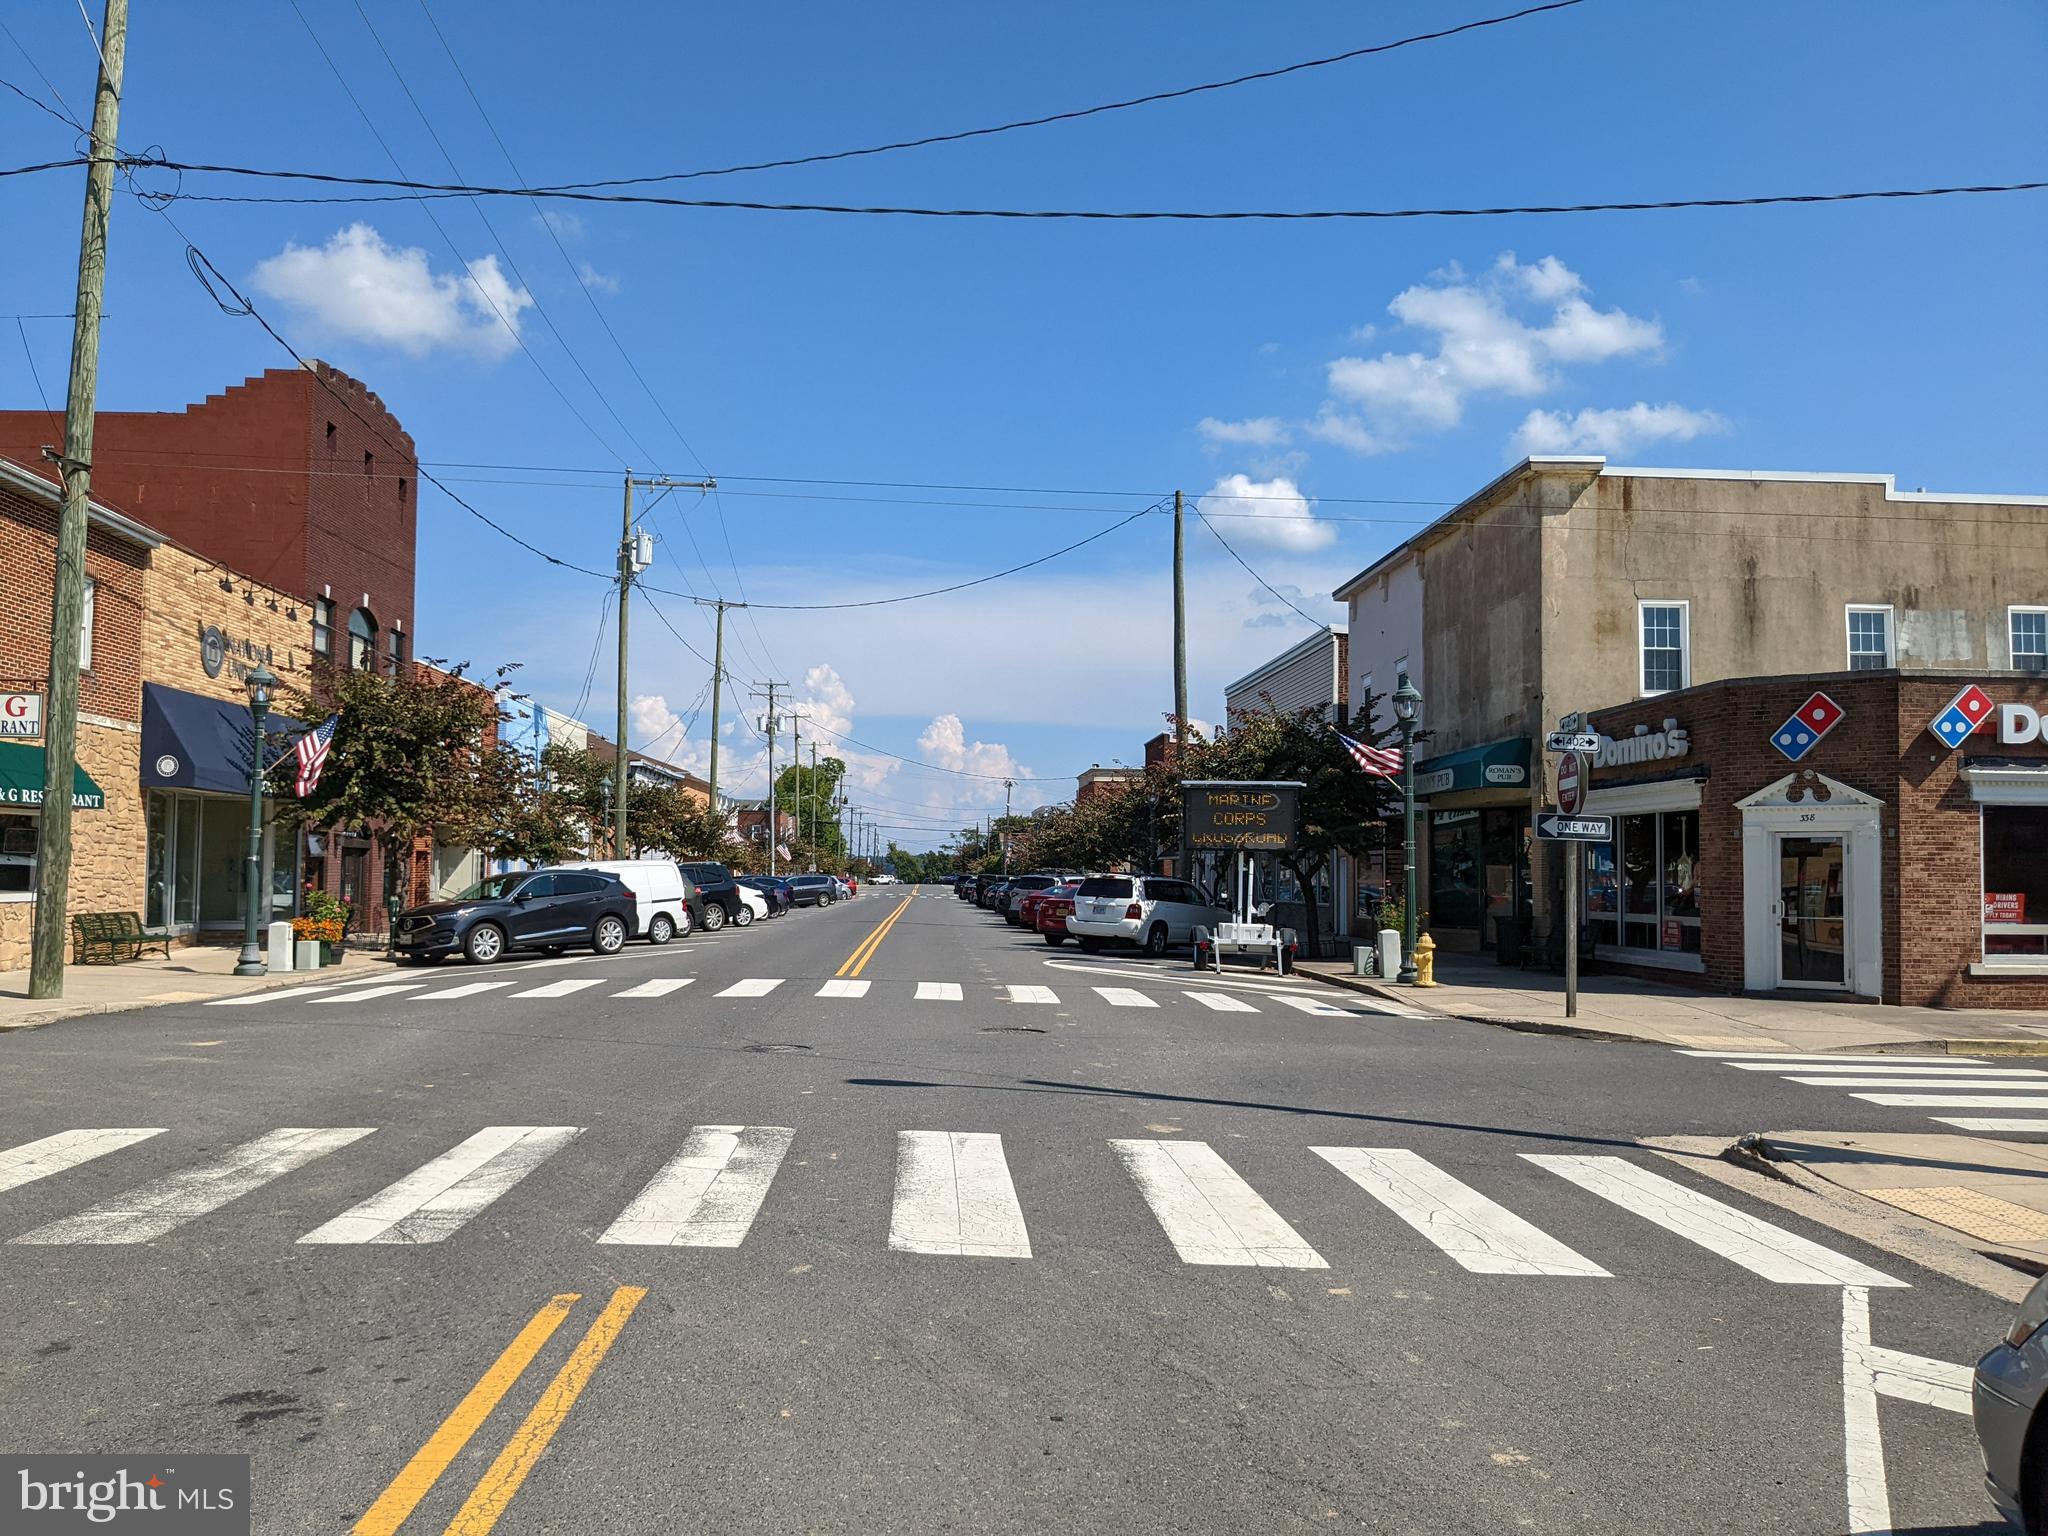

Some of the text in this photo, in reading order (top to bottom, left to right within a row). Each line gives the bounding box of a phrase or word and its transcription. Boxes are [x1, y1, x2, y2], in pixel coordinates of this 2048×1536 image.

[5, 695, 28, 717] G
[1, 720, 39, 734] RANT
[1562, 737, 1586, 747] 1402
[1592, 718, 1689, 768] Domino's
[1560, 765, 1568, 776] DO
[8, 788, 18, 801] G
[1213, 812, 1267, 826] CORPS
[1557, 822, 1604, 833] ONE WAY
[1996, 893, 2017, 901] HIRING
[1993, 901, 2019, 909] DRIVERS
